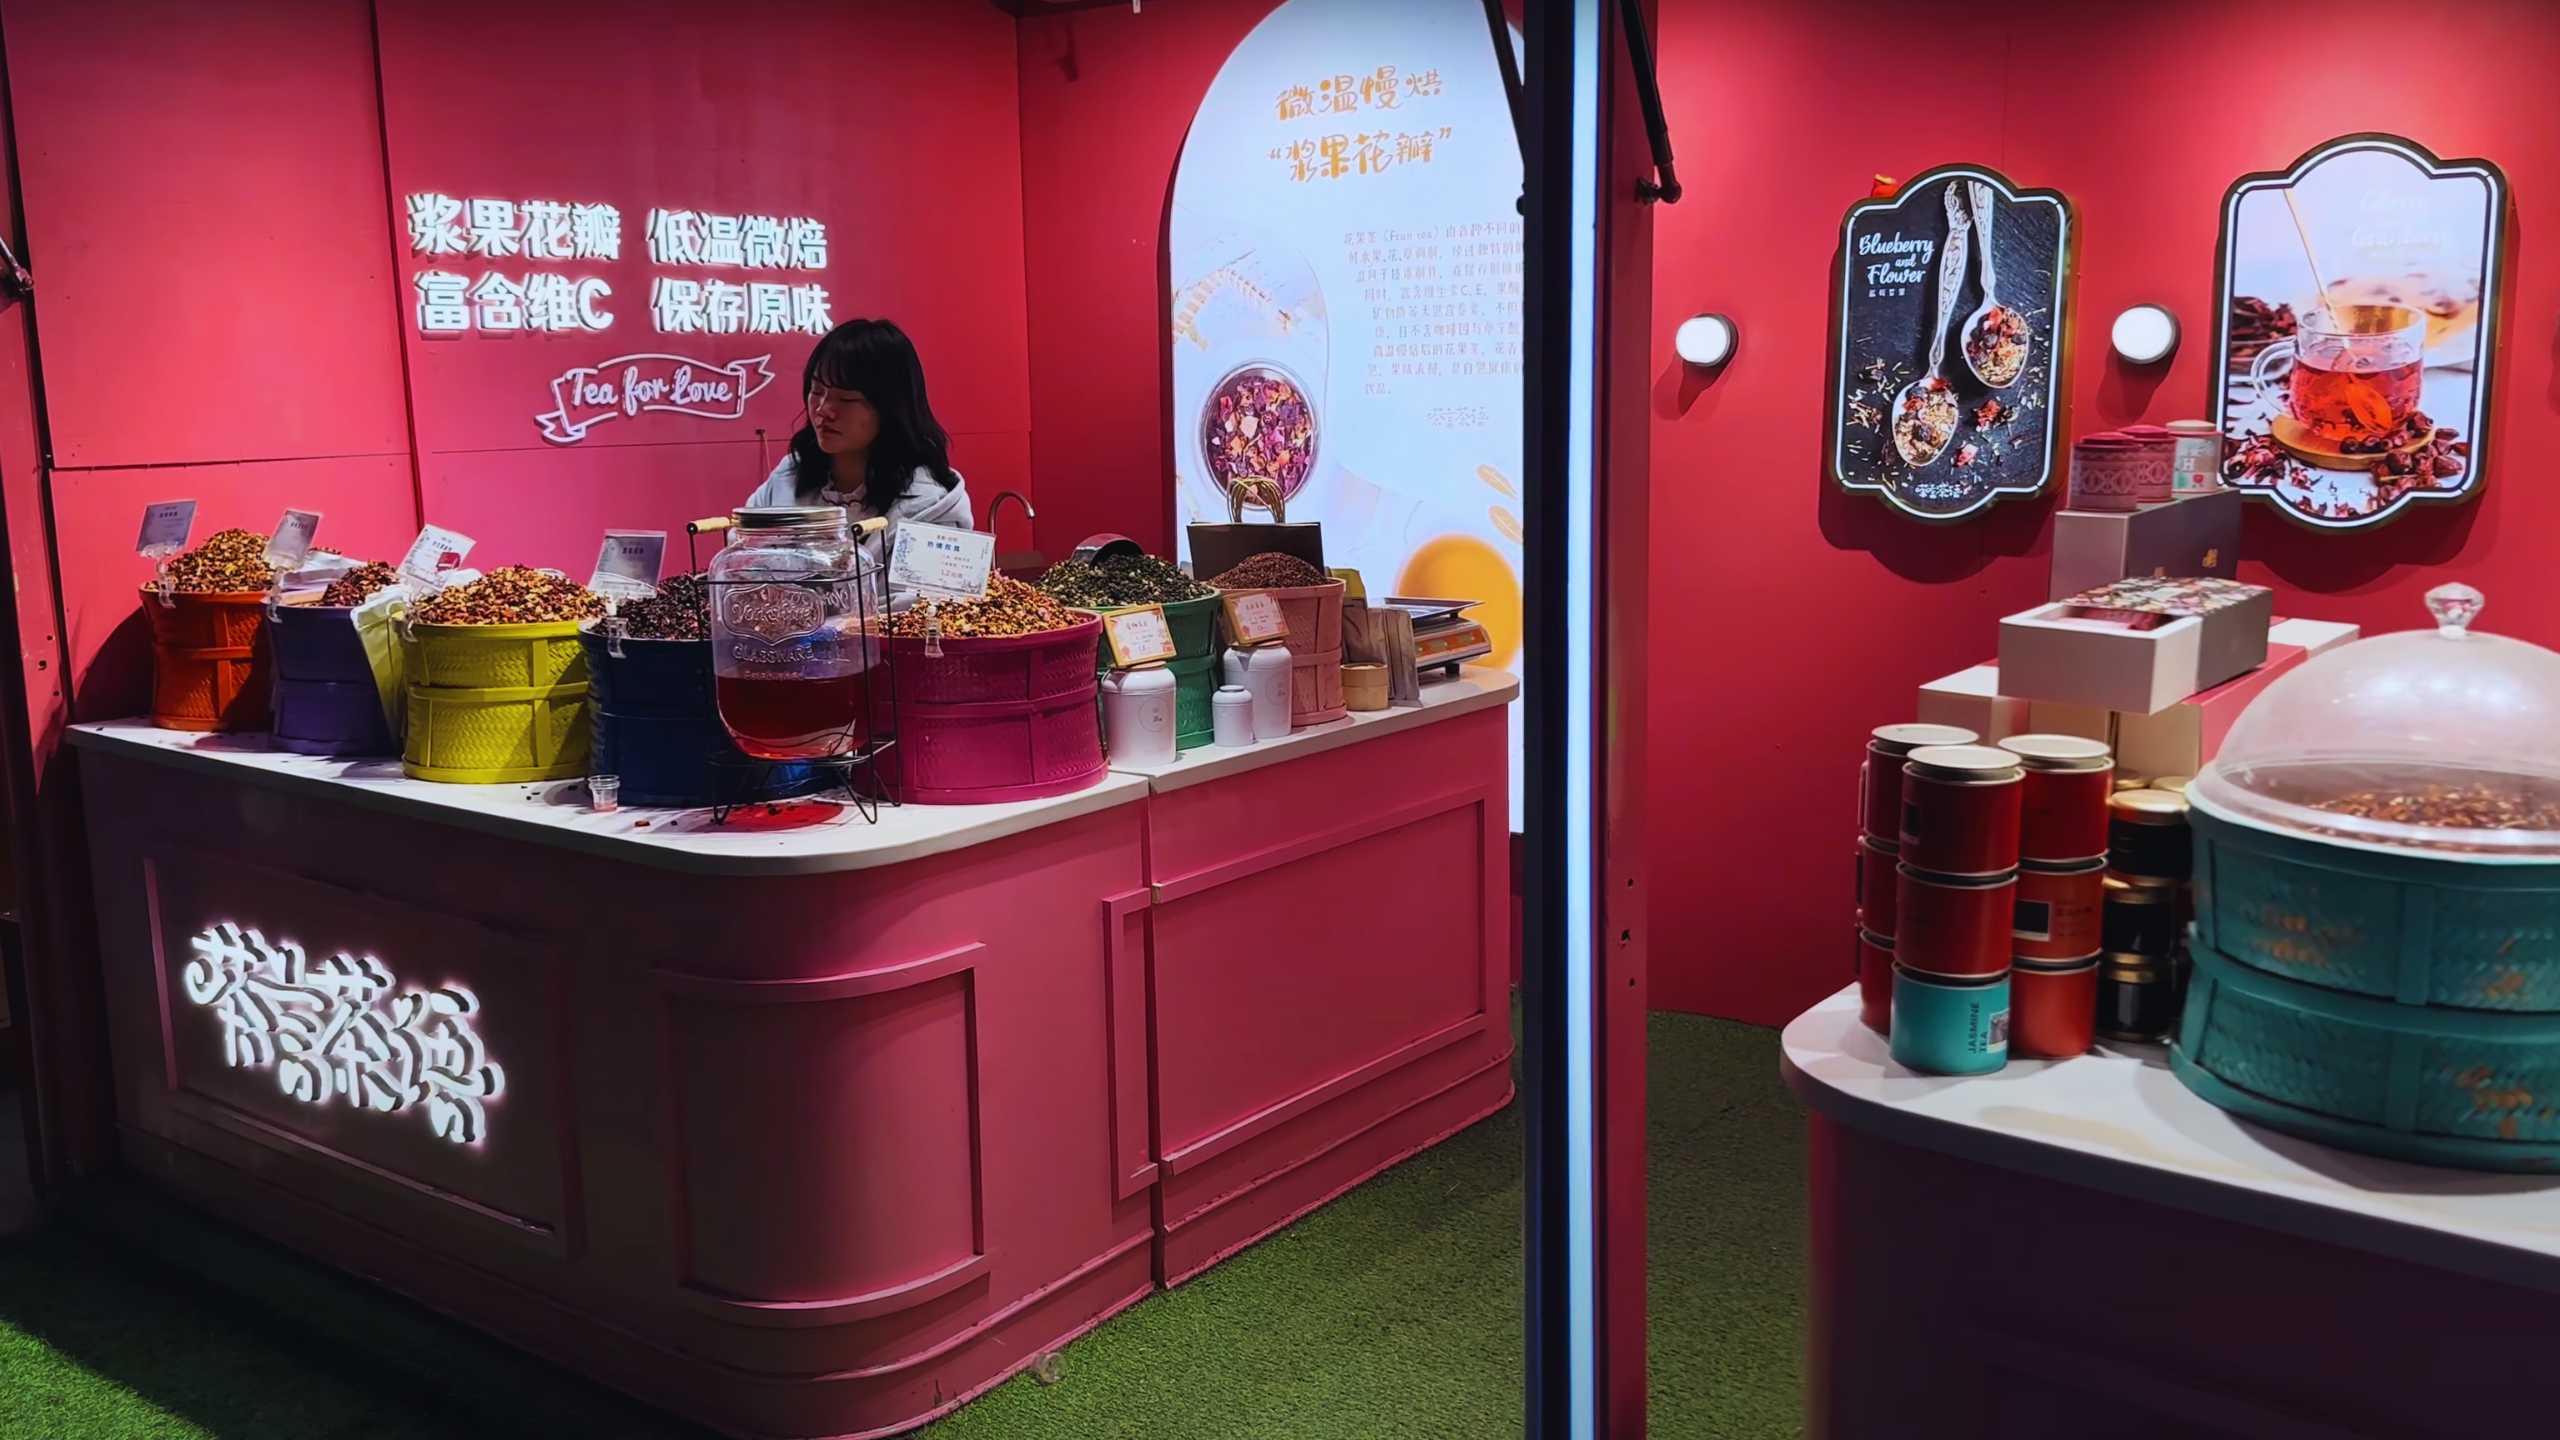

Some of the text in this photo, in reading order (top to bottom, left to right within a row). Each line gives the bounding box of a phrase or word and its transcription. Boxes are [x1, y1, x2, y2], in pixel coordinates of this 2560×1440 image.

[1275, 65, 1443, 121] 微温慢烘
[408, 193, 828, 269] 浆果花瓣 低温微焙
[1859, 231, 1935, 265] Blueberry
[1867, 262, 1926, 285] Flower
[1895, 253, 1917, 268] and
[415, 271, 834, 335] 富含维C 保存原味
[565, 365, 733, 416] Tea for Love
[1968, 1001, 1980, 1055] JASMINE
[1979, 1032, 1988, 1052] TEA
